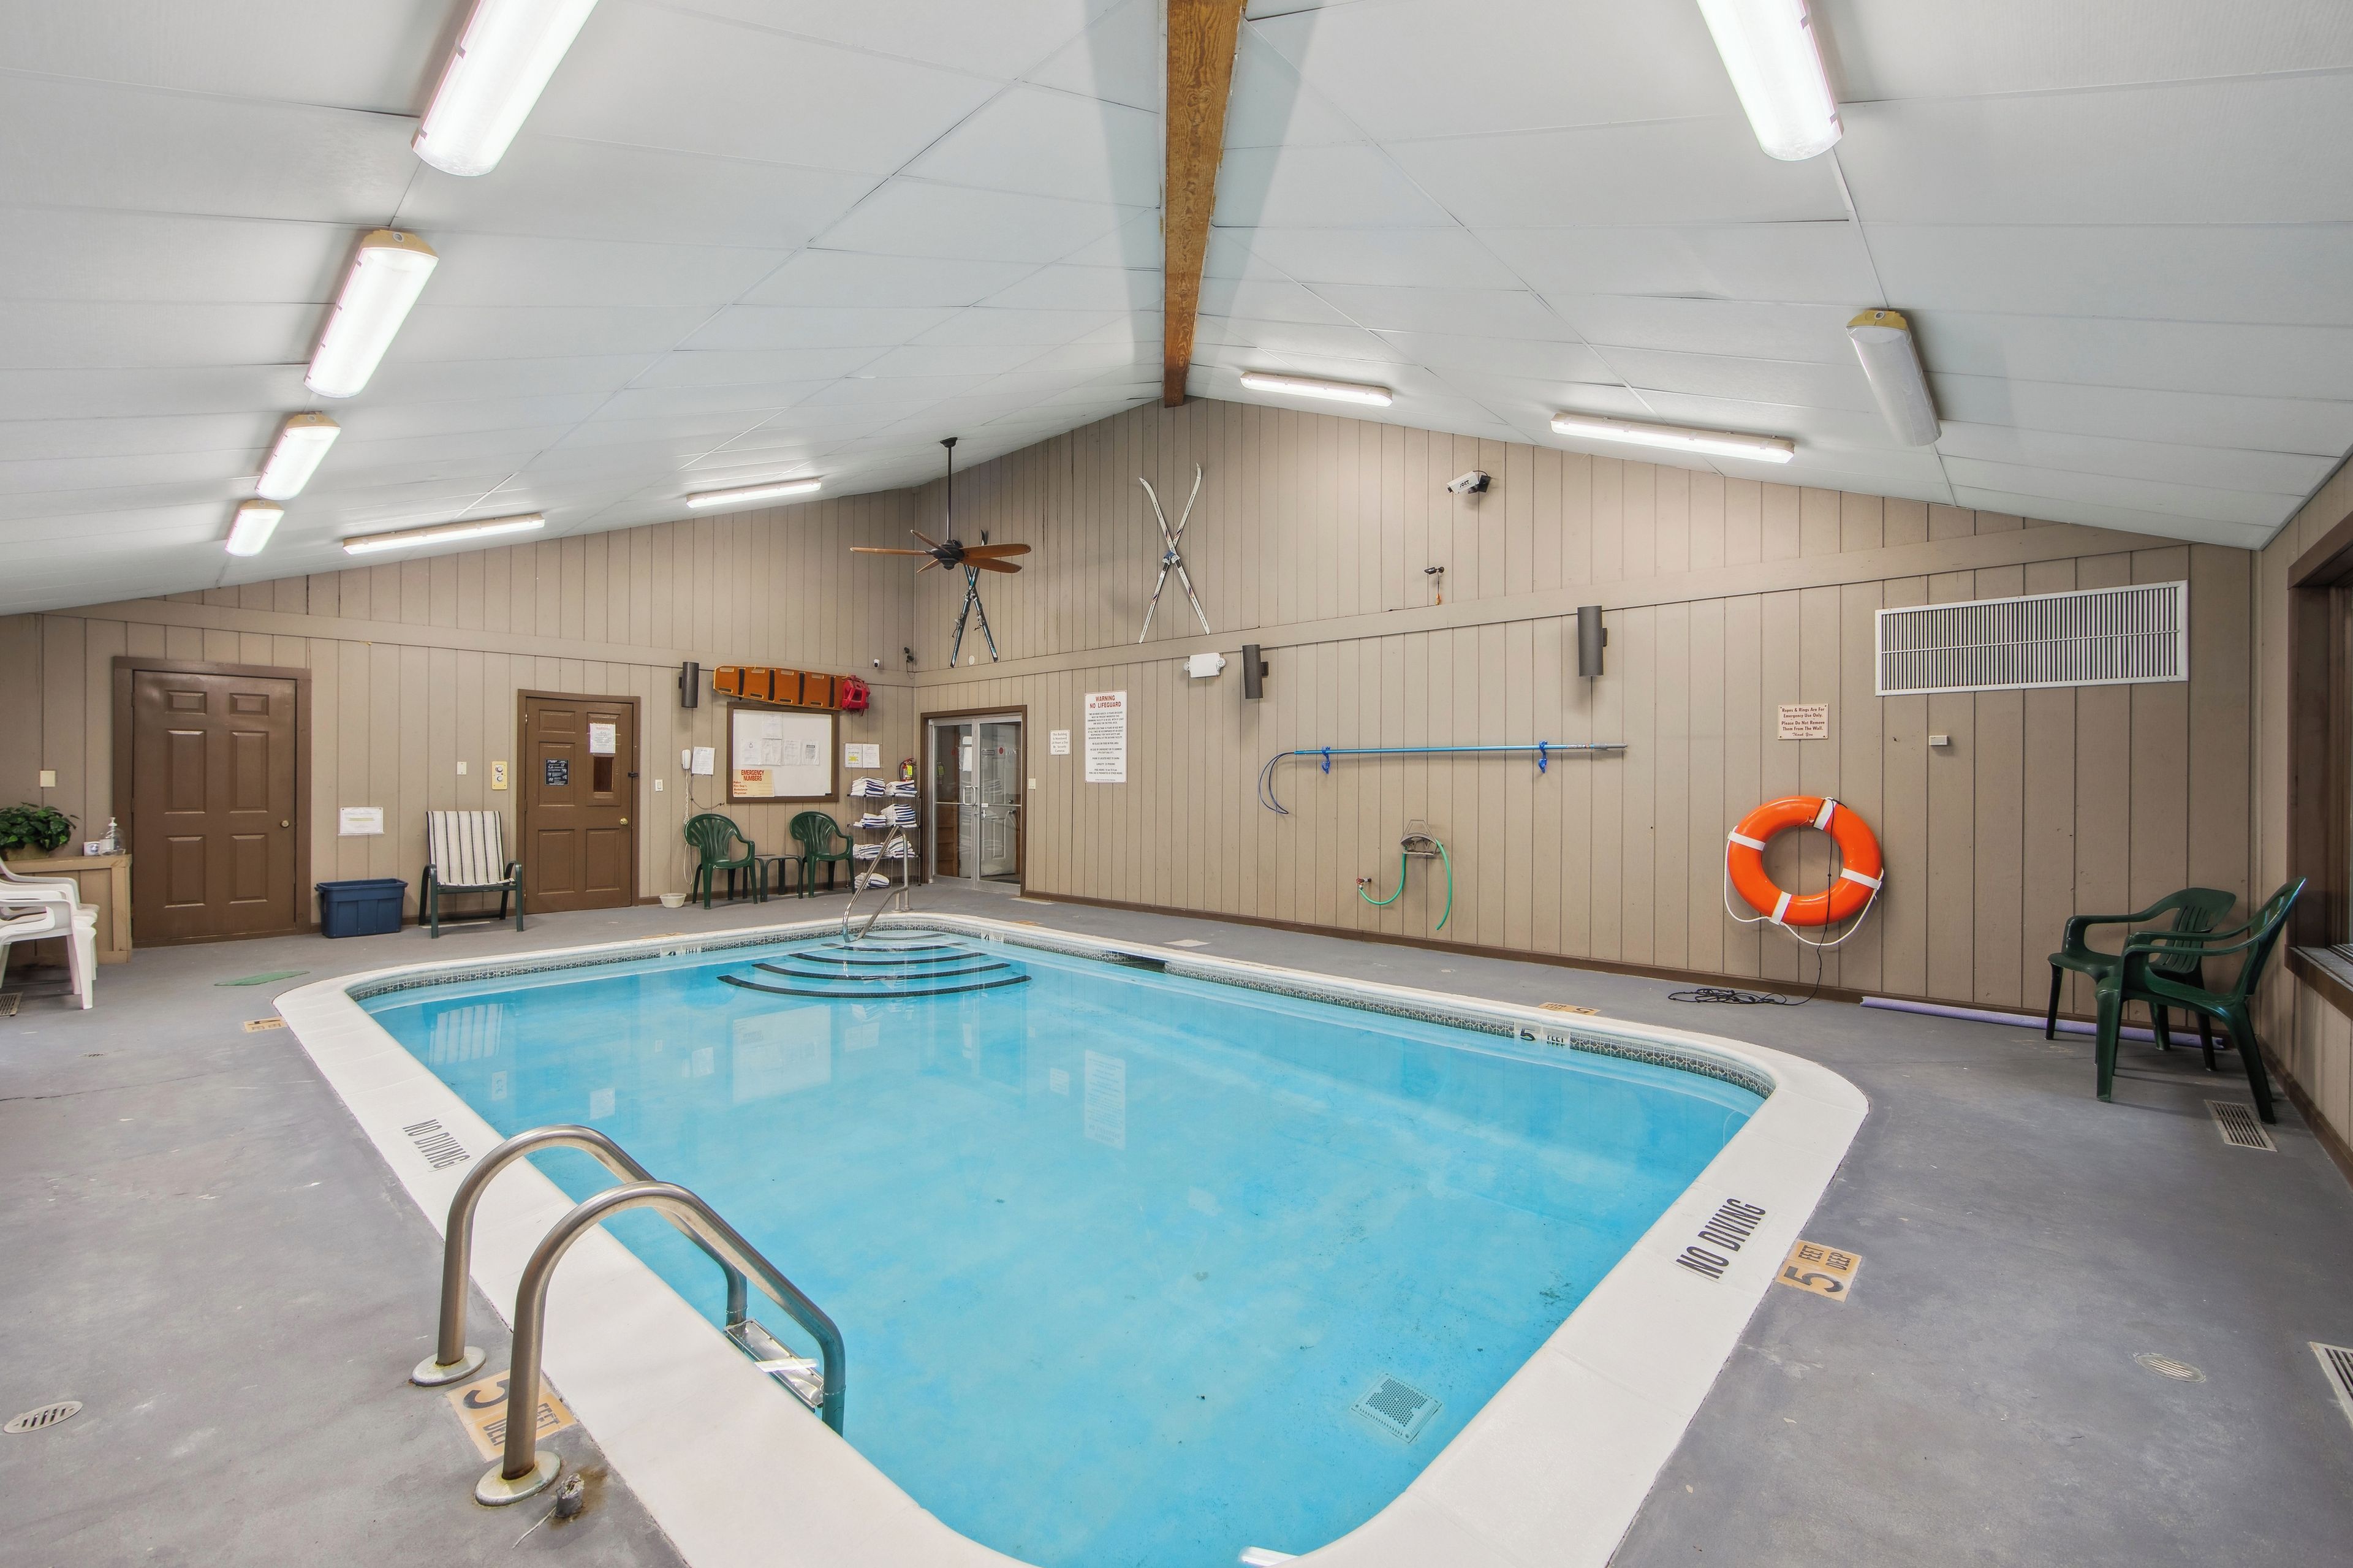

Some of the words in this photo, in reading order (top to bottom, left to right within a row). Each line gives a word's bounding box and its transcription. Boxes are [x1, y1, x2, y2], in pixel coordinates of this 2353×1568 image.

[1520, 1028, 1536, 1041] 5
[403, 1119, 442, 1136] NO
[413, 1132, 471, 1168] DIVING
[1697, 1199, 1766, 1252] DIVING
[1676, 1246, 1729, 1279] NO
[1798, 1245, 1824, 1262] FEET
[1825, 1252, 1851, 1270] DEEP
[1784, 1266, 1844, 1292] 5
